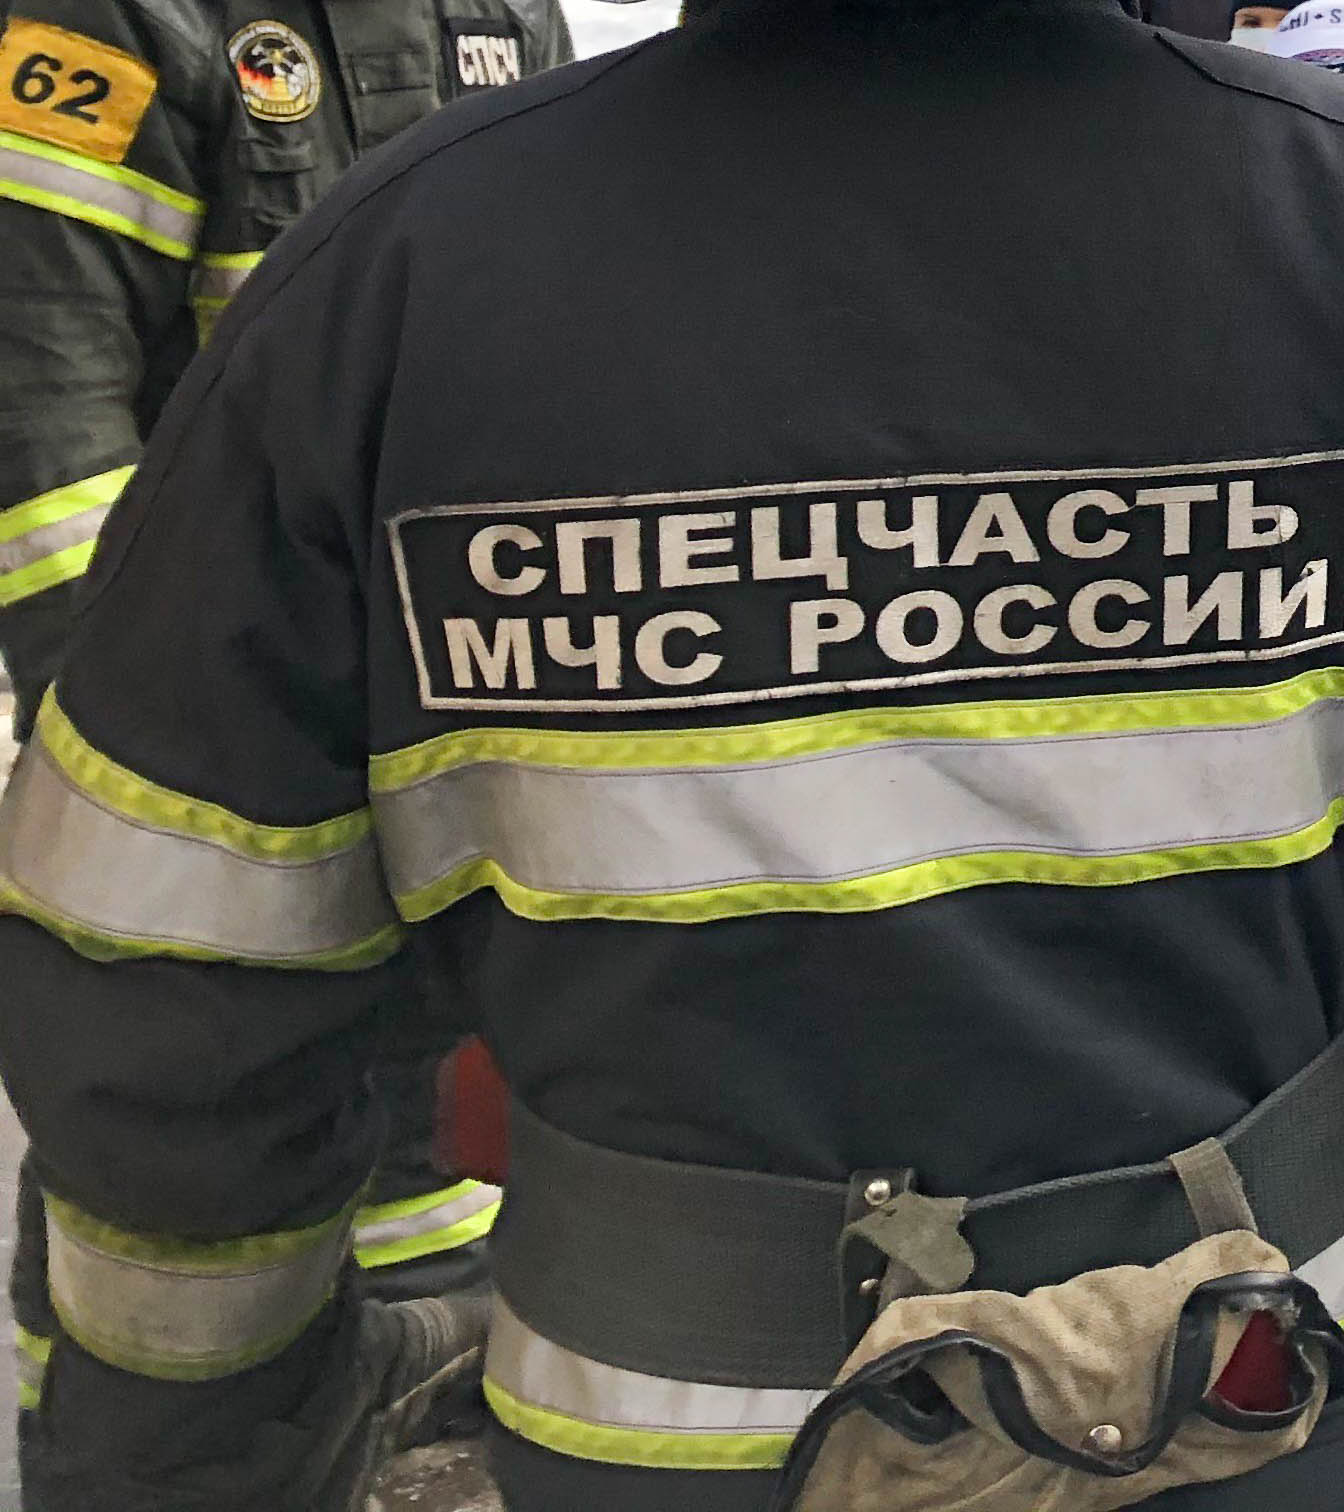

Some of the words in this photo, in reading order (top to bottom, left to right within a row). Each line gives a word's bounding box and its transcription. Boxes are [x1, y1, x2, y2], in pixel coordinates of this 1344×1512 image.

[11, 52, 111, 126] 62
[456, 34, 520, 87] СПСЧ
[467, 479, 1299, 596] СПЕЦЧАСТЬ
[443, 609, 724, 691] МЧС
[790, 558, 1330, 675] РОССИИ
